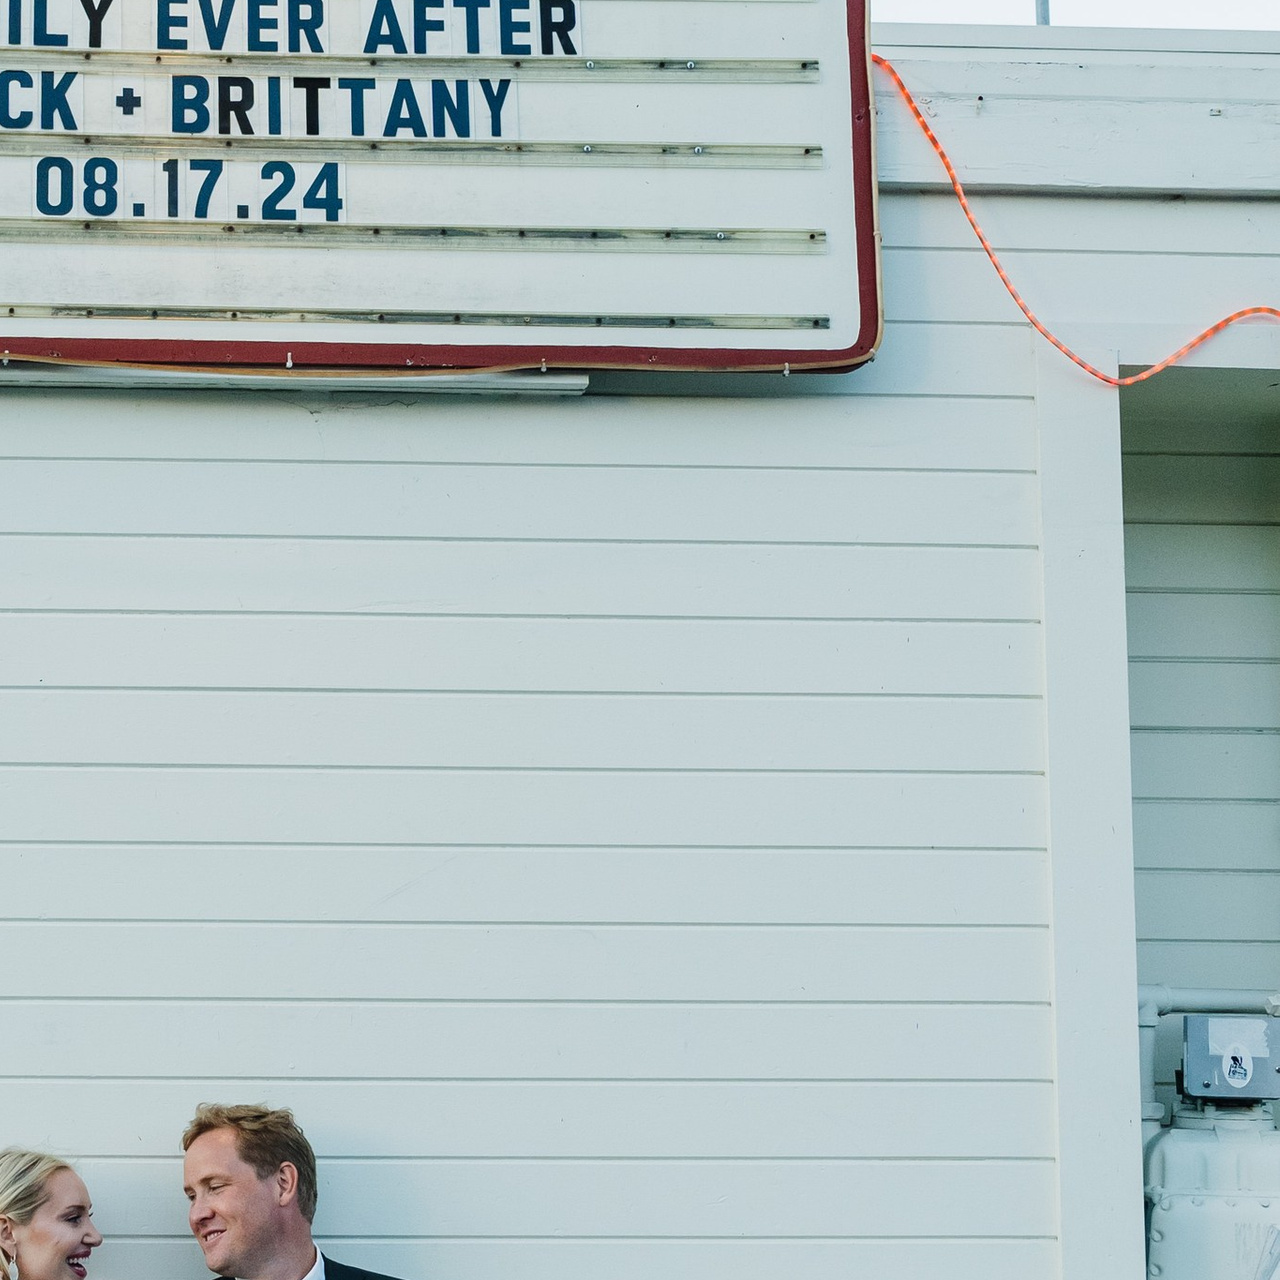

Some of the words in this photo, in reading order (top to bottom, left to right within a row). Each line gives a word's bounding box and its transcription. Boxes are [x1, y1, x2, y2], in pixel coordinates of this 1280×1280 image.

[116, 87, 141, 115] +
[172, 75, 511, 137] BRITTANY
[36, 156, 343, 222] 08.17.24
